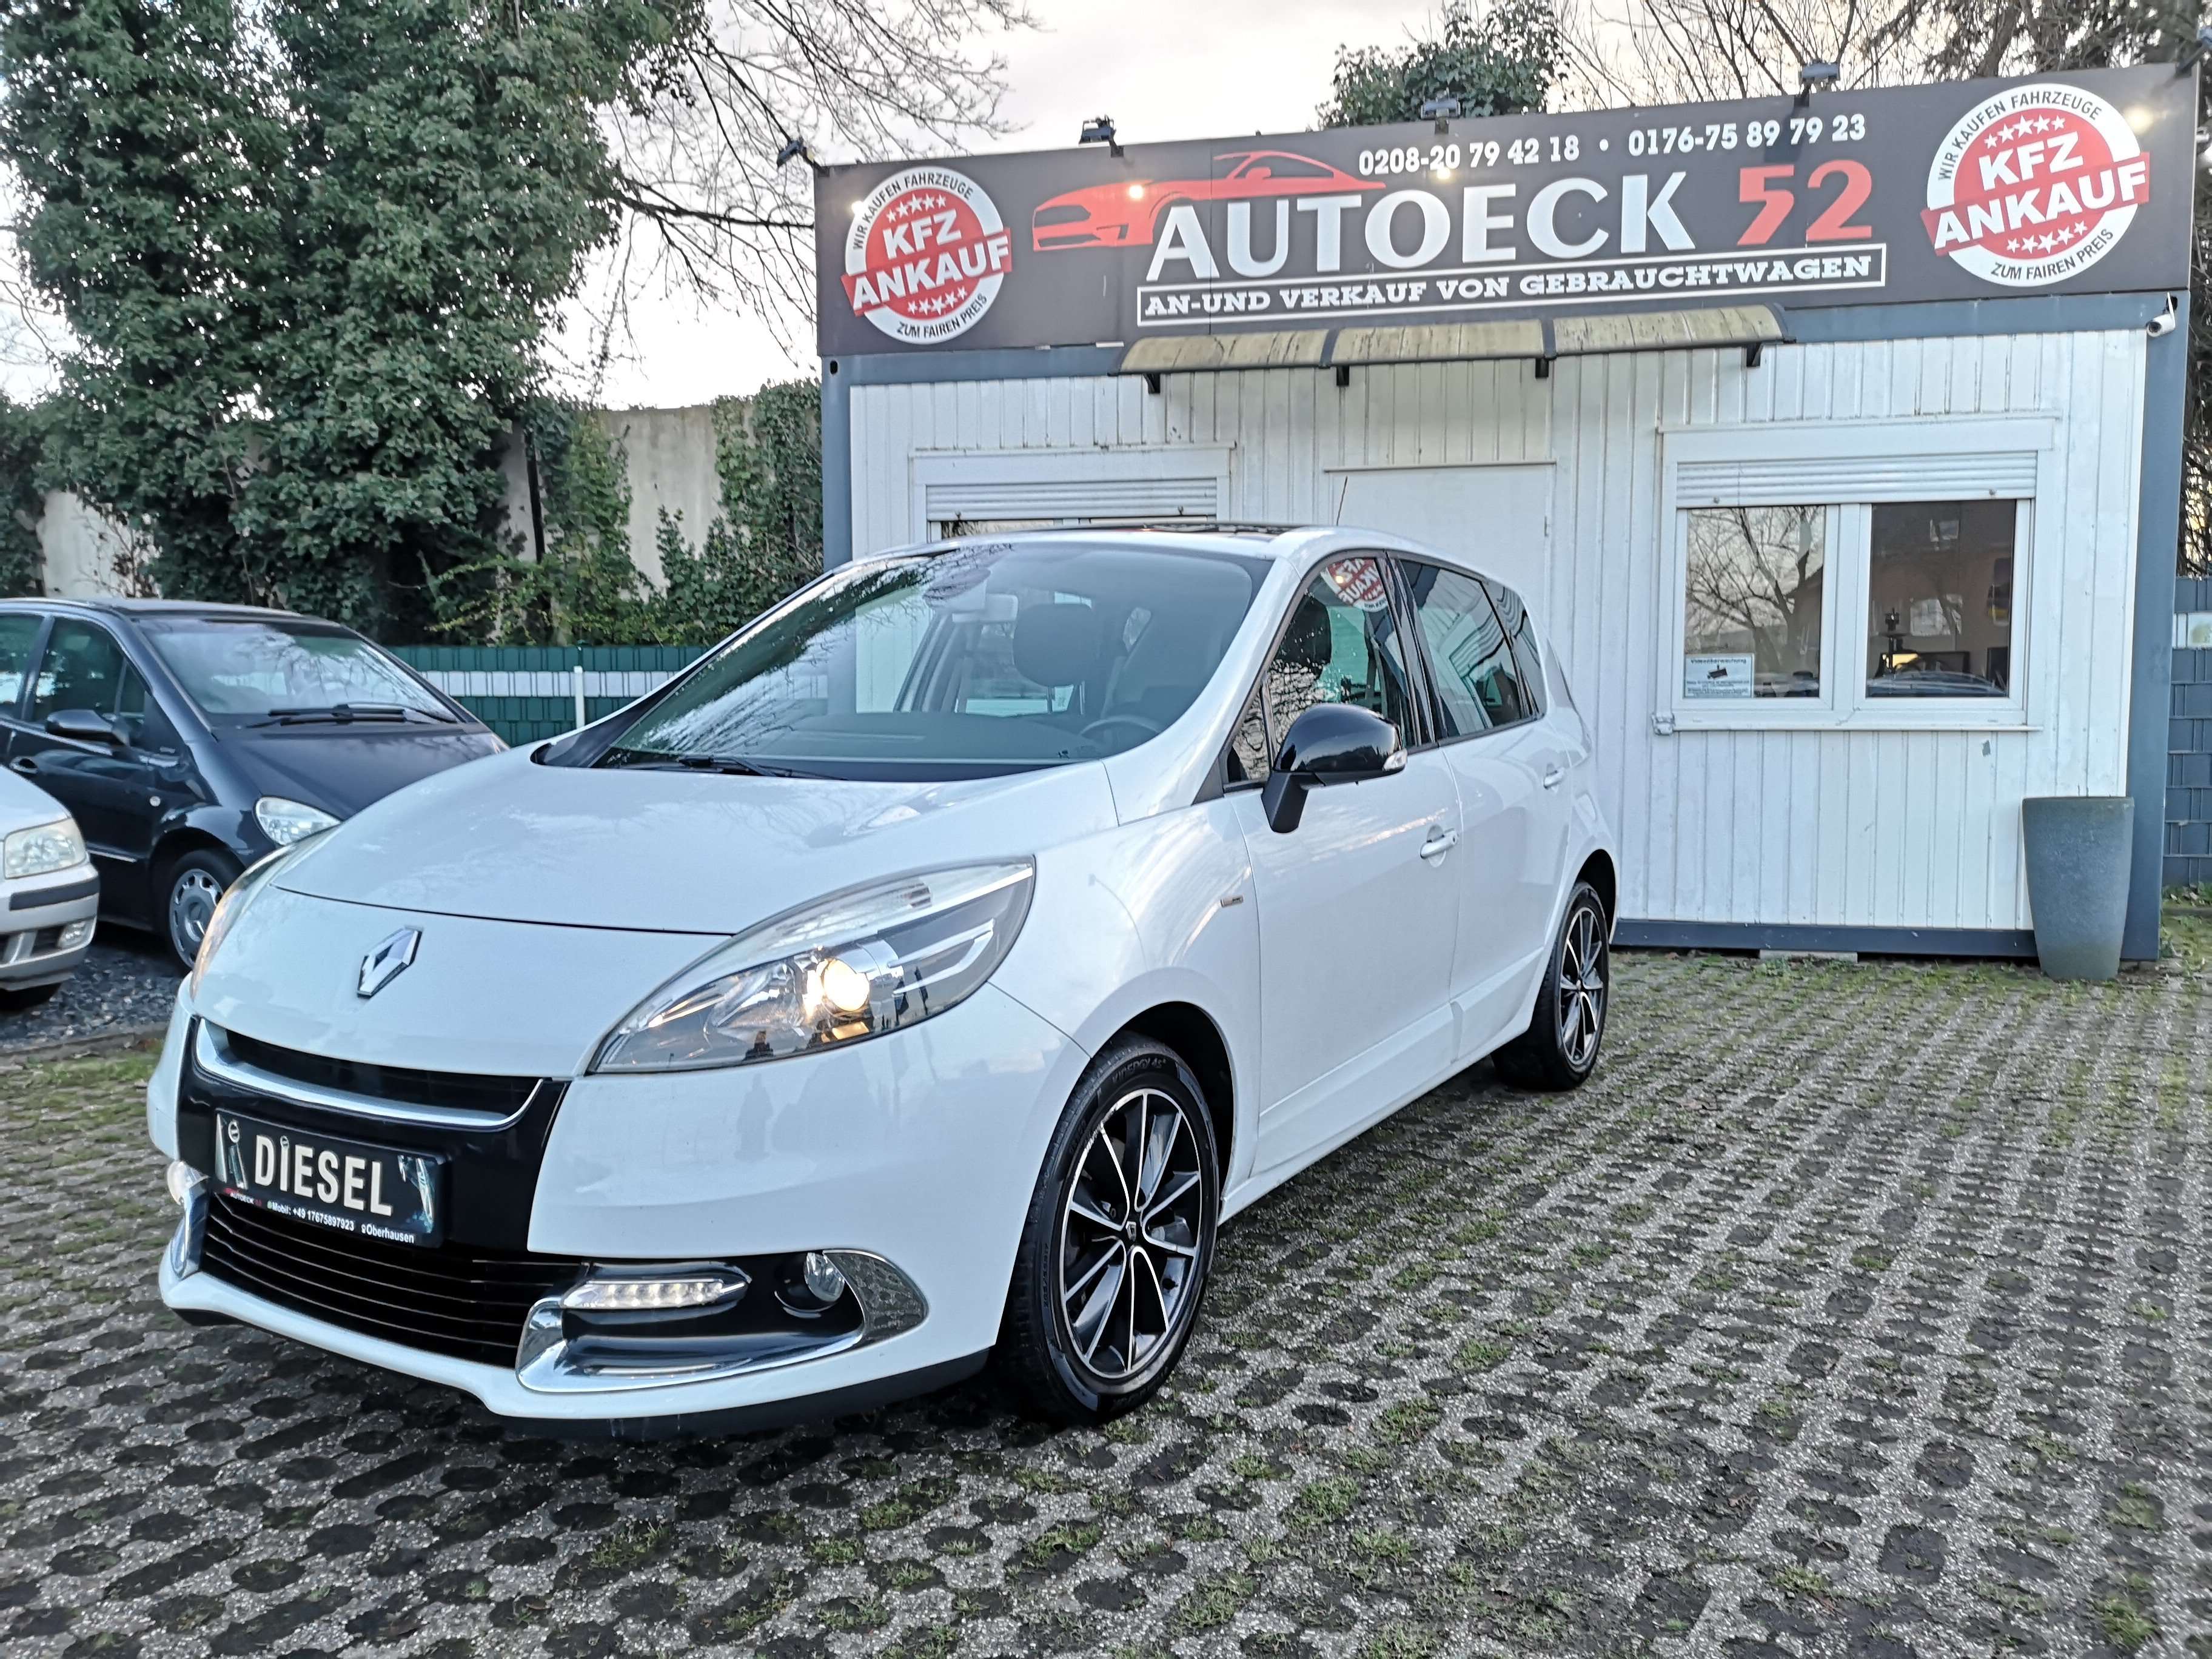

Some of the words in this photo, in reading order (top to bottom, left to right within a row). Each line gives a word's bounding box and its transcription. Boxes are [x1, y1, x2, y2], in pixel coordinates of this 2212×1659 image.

[1358, 144, 1460, 176] 0208-20
[1469, 140, 1500, 168] 79
[1507, 138, 1540, 165] 42
[1550, 135, 1580, 162] 18
[1628, 123, 1738, 156] 0176-75
[1746, 120, 1780, 149] 89
[1790, 117, 1823, 145] 79
[1832, 113, 1866, 142] 23
[1939, 153, 1959, 181] WIR
[1952, 101, 2006, 149] KAUFEN
[2011, 91, 2102, 121] FAHRZEUGE
[1979, 131, 2083, 191] KFZ
[853, 225, 868, 250] WIR
[863, 185, 902, 223] KAUFEN
[905, 172, 974, 200] FAHRZEUGE
[883, 209, 961, 260] KFZ
[1146, 171, 1696, 281] AUTOECK
[1737, 159, 1872, 246] 52
[1934, 161, 2146, 249] ANKAUF
[854, 235, 1008, 310] ANKAUF
[1991, 262, 2022, 280] ZUM
[2026, 256, 2076, 280] FAIREN
[2077, 228, 2114, 263] PREIS
[1145, 291, 1270, 315] AN-UND
[1280, 283, 1427, 308] VERKAUF
[1437, 277, 1509, 300] VON
[1520, 256, 1872, 296] GEBRAUCHTWAGEN
[897, 321, 920, 338] ZUM
[924, 320, 960, 338] FAIREN
[962, 293, 987, 324] PREIS
[367, 1224, 415, 1244] Oberhausen
